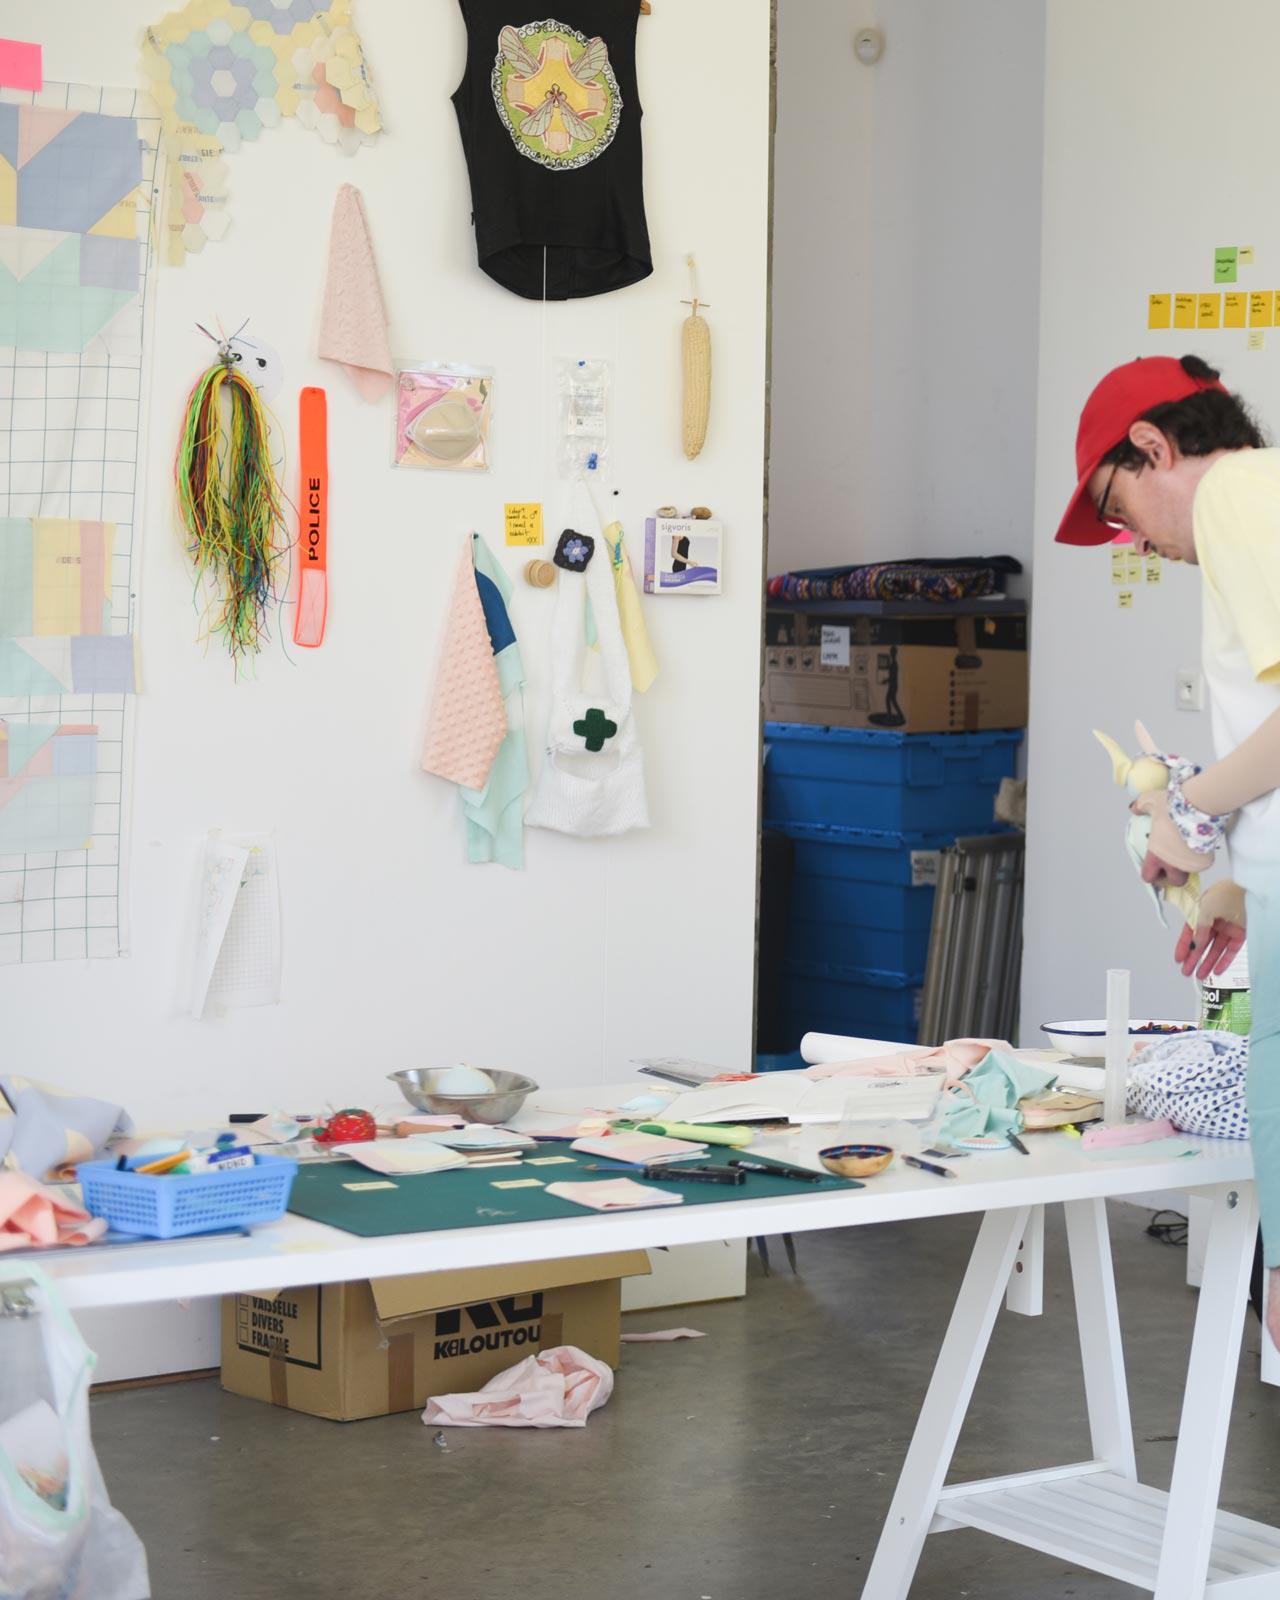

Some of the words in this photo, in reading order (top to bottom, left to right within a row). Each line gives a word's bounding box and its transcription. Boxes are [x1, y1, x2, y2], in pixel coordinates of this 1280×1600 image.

[308, 477, 320, 561] POLICE
[252, 1297, 298, 1319] VAISSELLE
[252, 1312, 284, 1334] DIVERS
